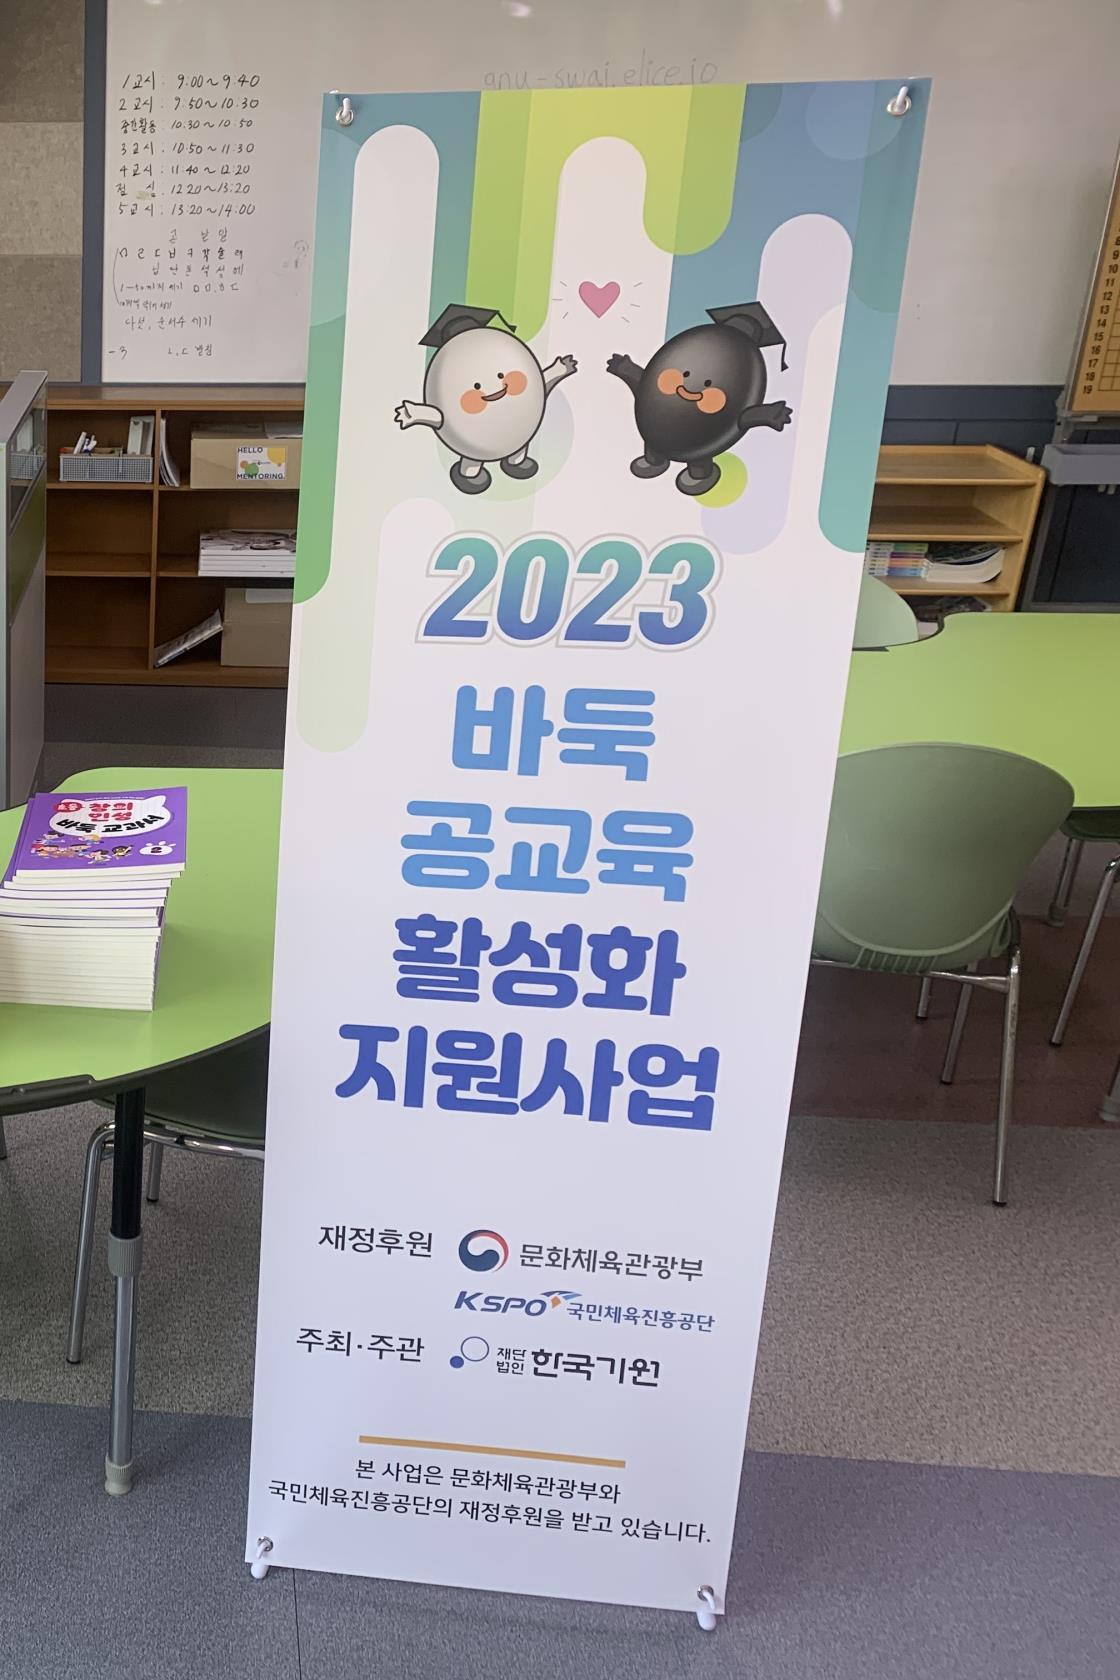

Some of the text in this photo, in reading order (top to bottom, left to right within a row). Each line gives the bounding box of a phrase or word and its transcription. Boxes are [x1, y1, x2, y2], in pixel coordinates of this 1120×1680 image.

[1103, 291, 1113, 301] 12
[1105, 278, 1115, 288] 11
[1097, 318, 1106, 328] 14
[1100, 305, 1110, 315] 13
[1094, 331, 1104, 341] 15
[1088, 358, 1098, 368] 17
[237, 446, 263, 454] HELLO
[417, 532, 721, 650] 2023
[452, 684, 656, 781] 바둑
[56, 814, 165, 833] 바둑 교과서
[401, 800, 694, 902] 공교육
[393, 913, 687, 1016] 활성화
[335, 1023, 720, 1131] 지원사업
[318, 1225, 704, 1282] 재정후원 문화체육관광부
[454, 1291, 716, 1333] KSPO 국민체육진흥공단
[496, 1346, 527, 1362] 재단
[496, 1361, 525, 1375] 법인
[531, 1349, 661, 1388] 한국기원
[355, 1459, 621, 1504] 본 사업은 문화체육관광부와
[268, 1479, 712, 1543] 국민체육진흥공단의 재정후원을 받고 있습니다.
